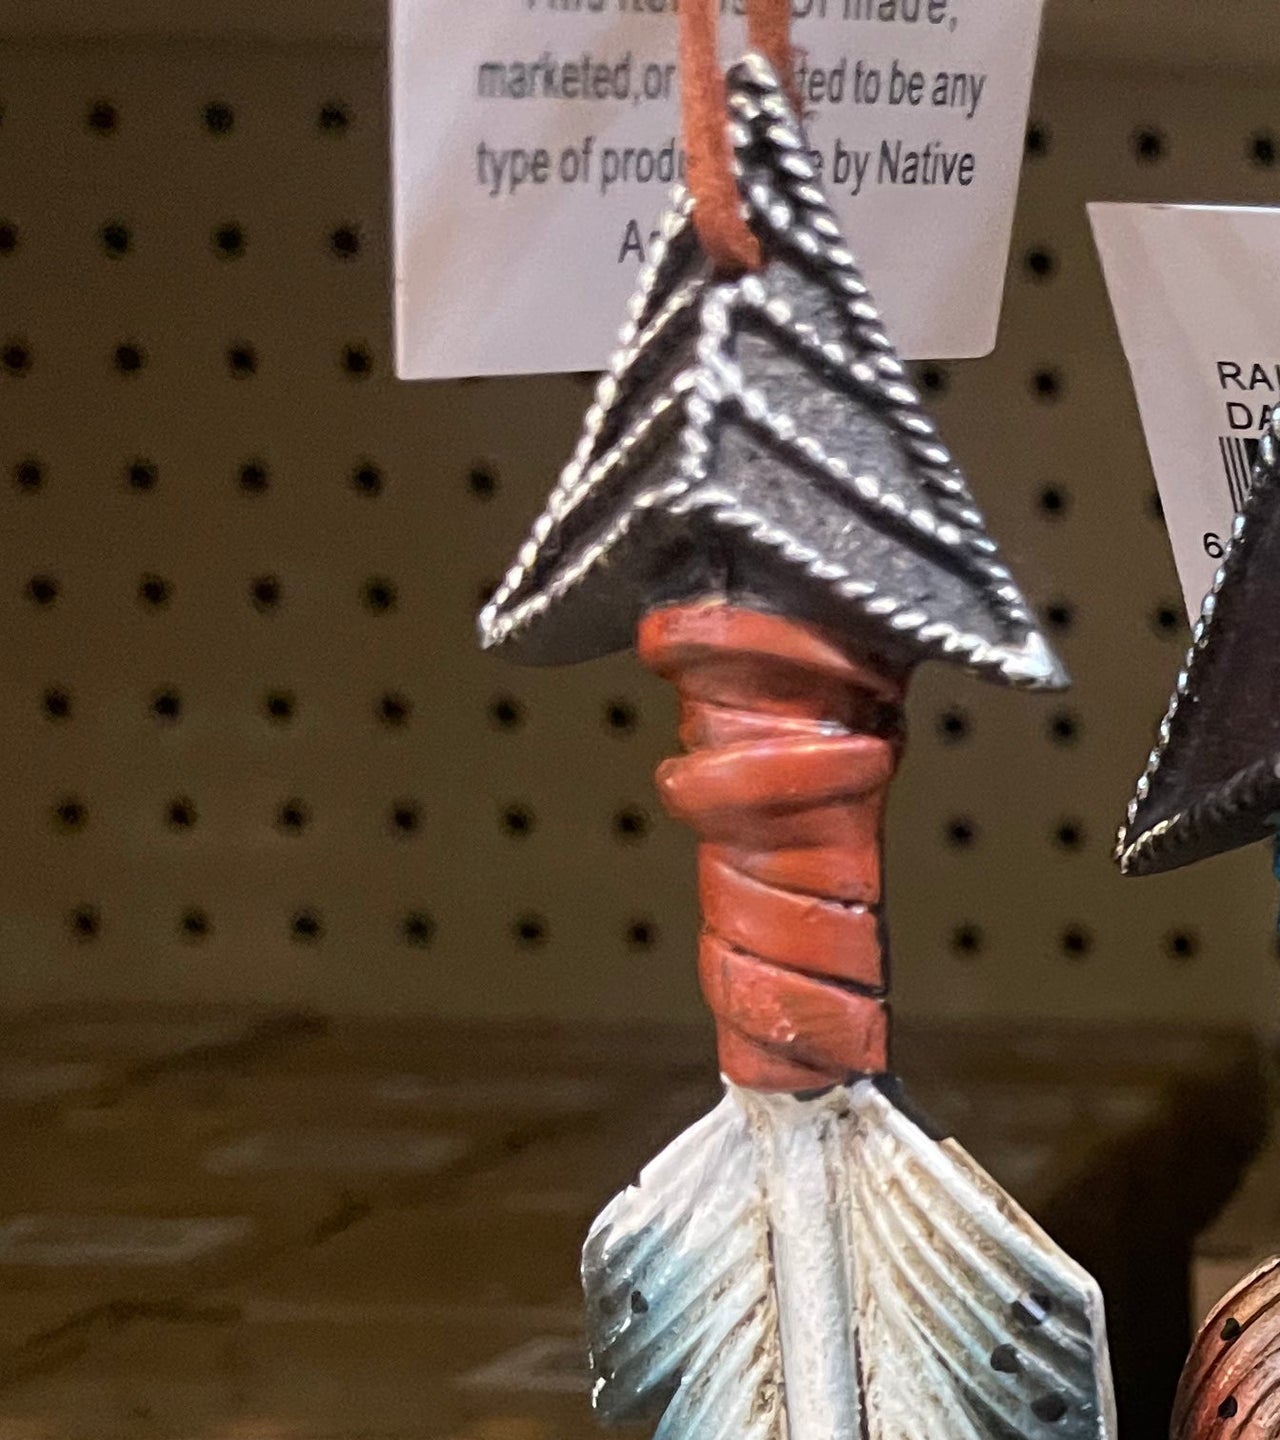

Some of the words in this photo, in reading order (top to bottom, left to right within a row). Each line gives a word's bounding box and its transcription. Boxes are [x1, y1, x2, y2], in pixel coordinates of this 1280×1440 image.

[855, 61, 880, 104] to
[889, 59, 924, 105] be
[932, 72, 986, 119] any
[477, 141, 549, 197] type
[560, 136, 593, 182] of
[602, 137, 685, 192] prod
[834, 138, 870, 196] by
[878, 140, 975, 186] Native
